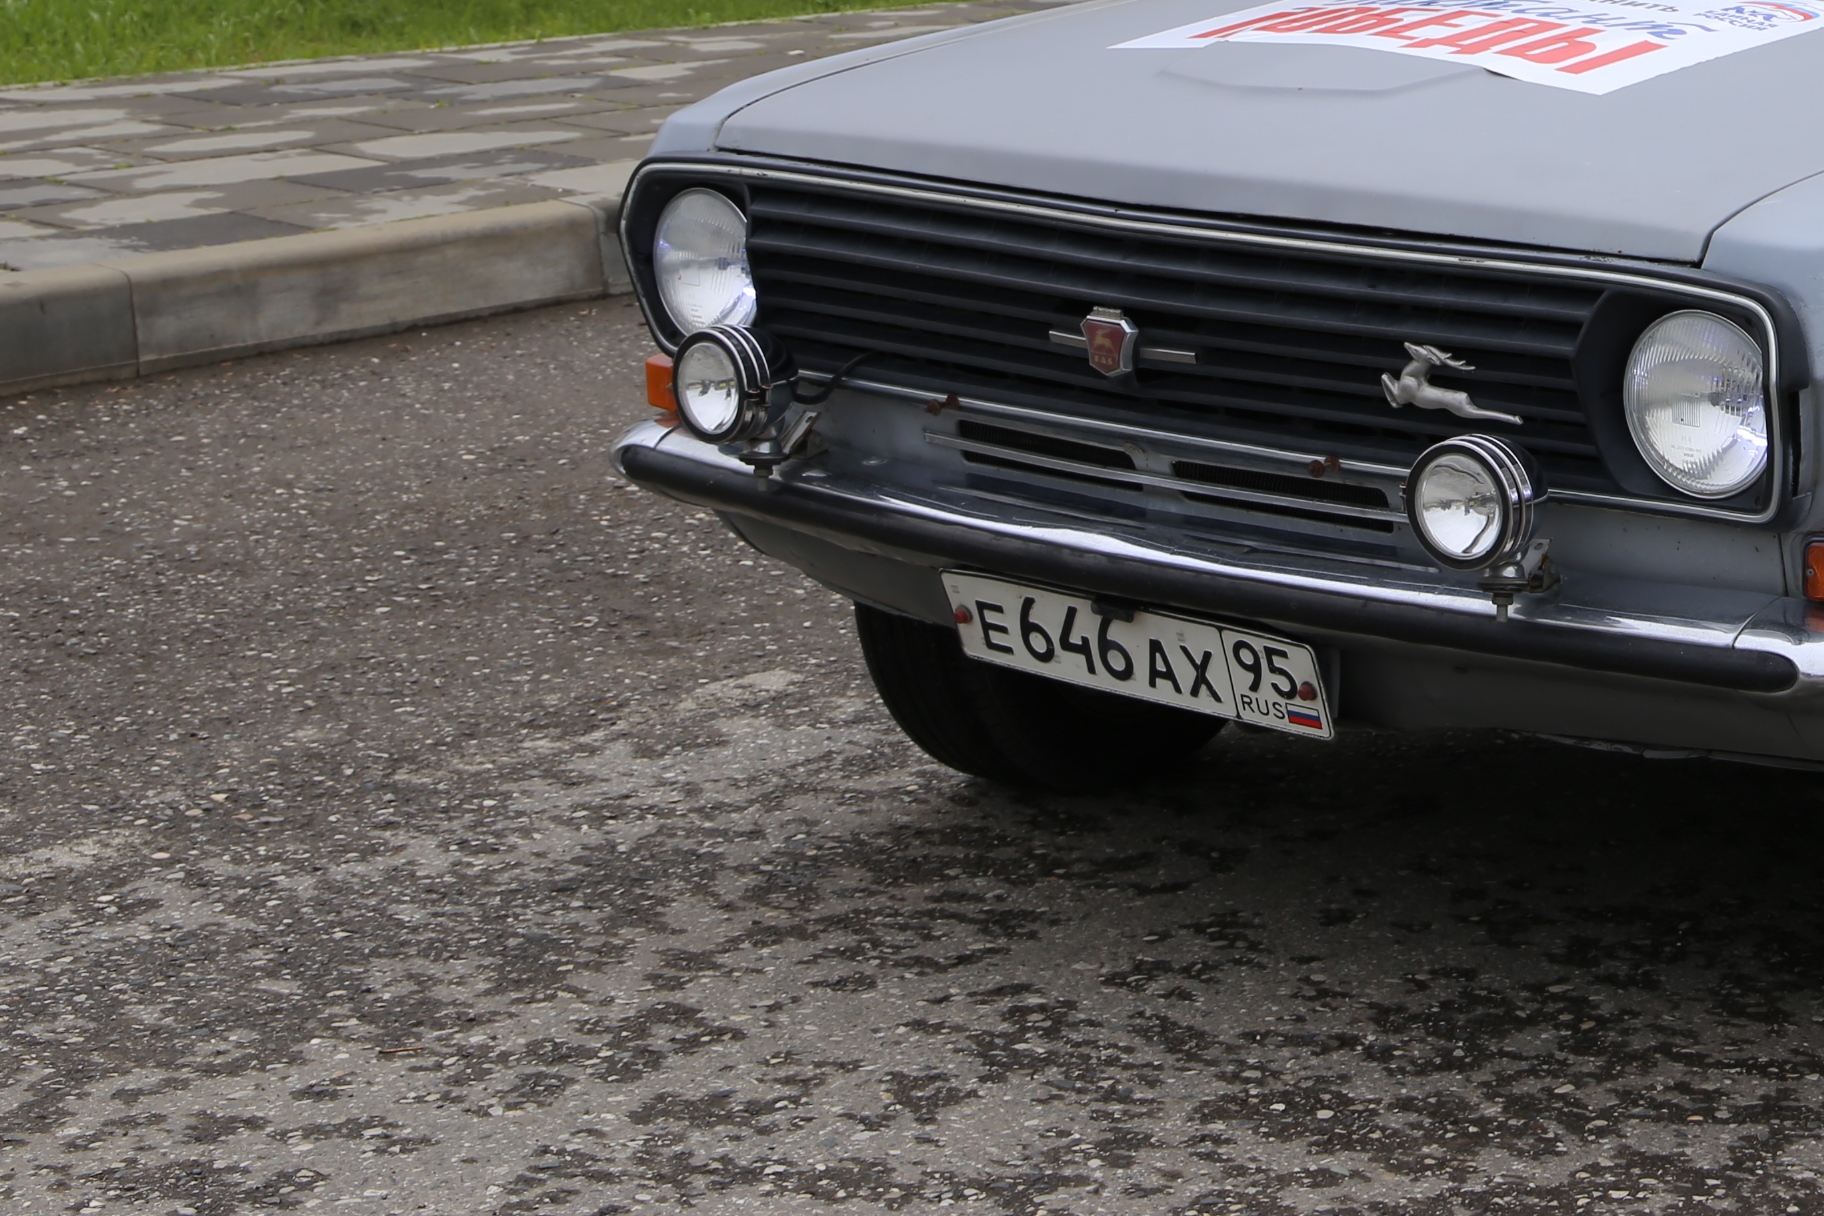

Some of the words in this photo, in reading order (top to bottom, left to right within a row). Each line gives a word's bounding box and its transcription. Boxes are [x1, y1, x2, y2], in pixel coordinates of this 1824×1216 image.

[1187, 6, 1669, 75] ПОБЕДЫ
[1231, 638, 1299, 701] 95
[1239, 692, 1287, 721] RUS
